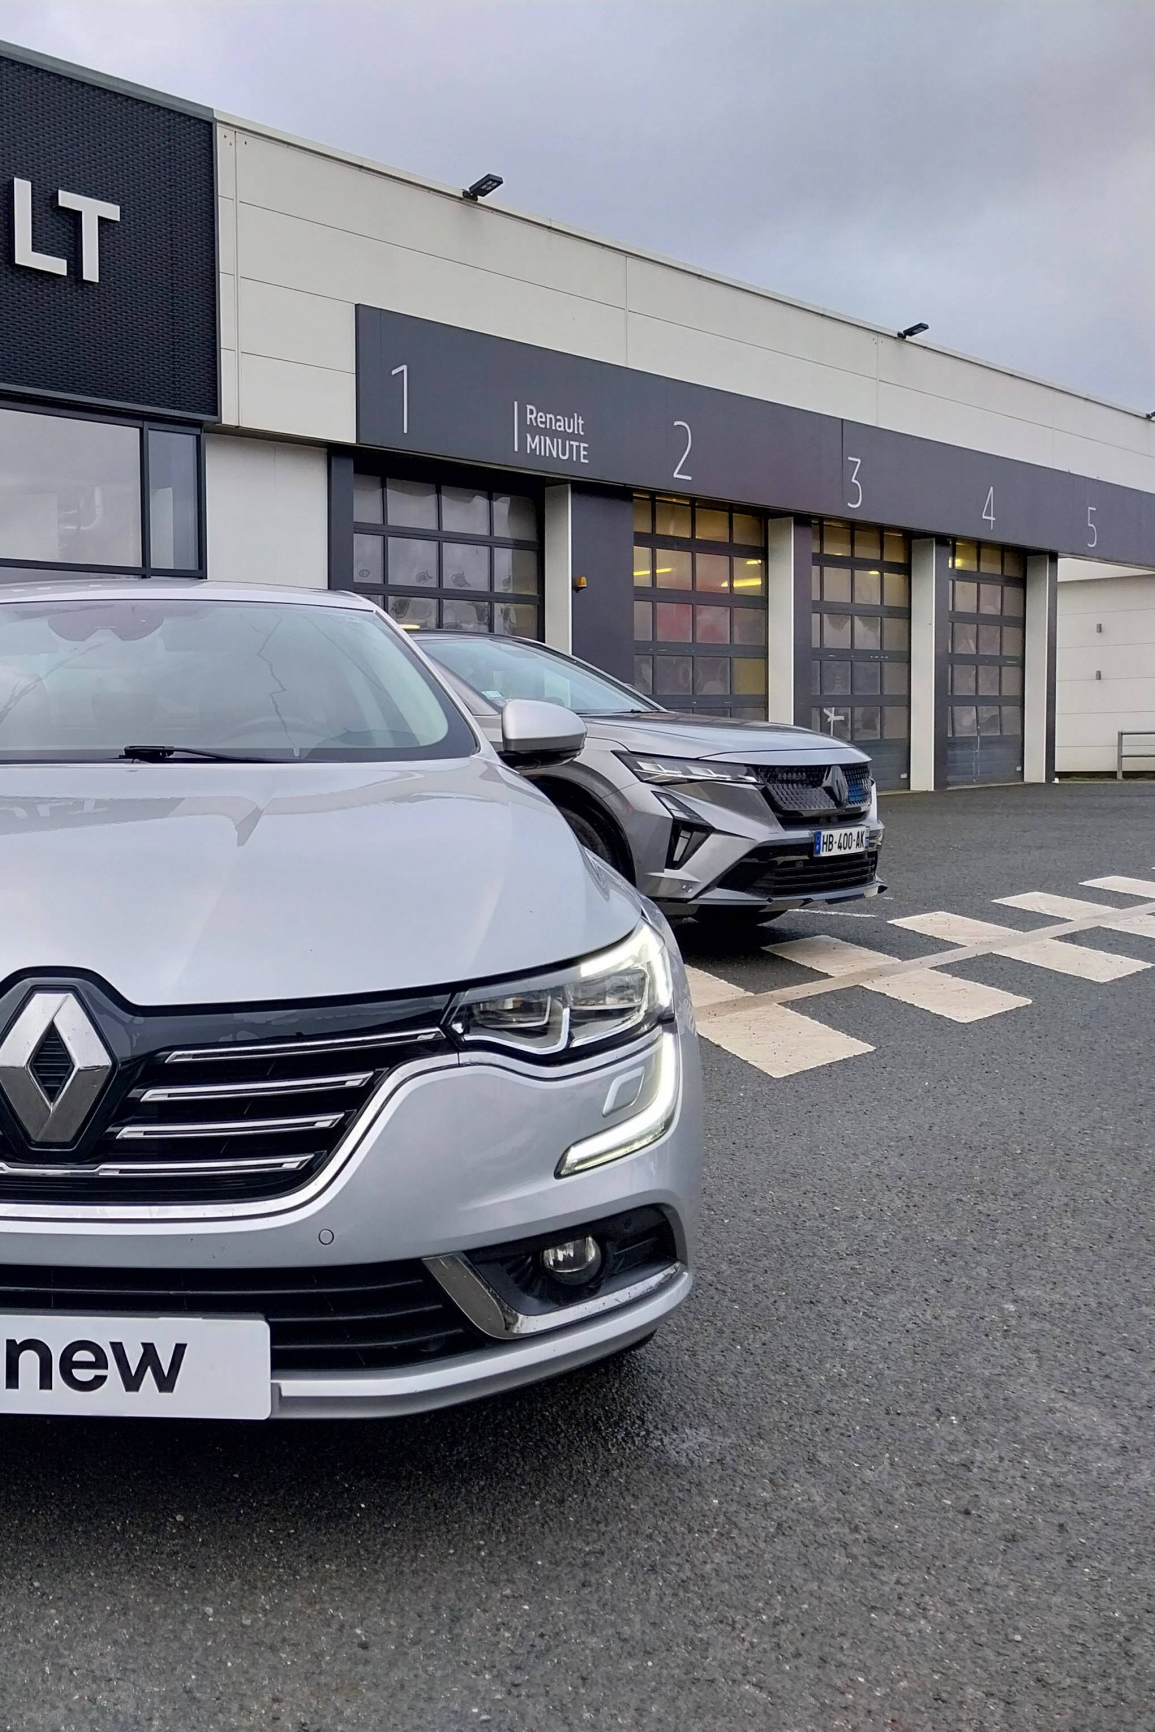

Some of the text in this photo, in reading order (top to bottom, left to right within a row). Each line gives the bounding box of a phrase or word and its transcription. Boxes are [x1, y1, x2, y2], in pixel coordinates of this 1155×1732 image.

[391, 364, 408, 434] 1
[526, 404, 585, 436] Renault
[526, 433, 589, 464] MINUTE
[673, 421, 692, 480] 2
[847, 456, 863, 508] 3
[982, 486, 996, 530] 4
[1087, 507, 1097, 547] 5
